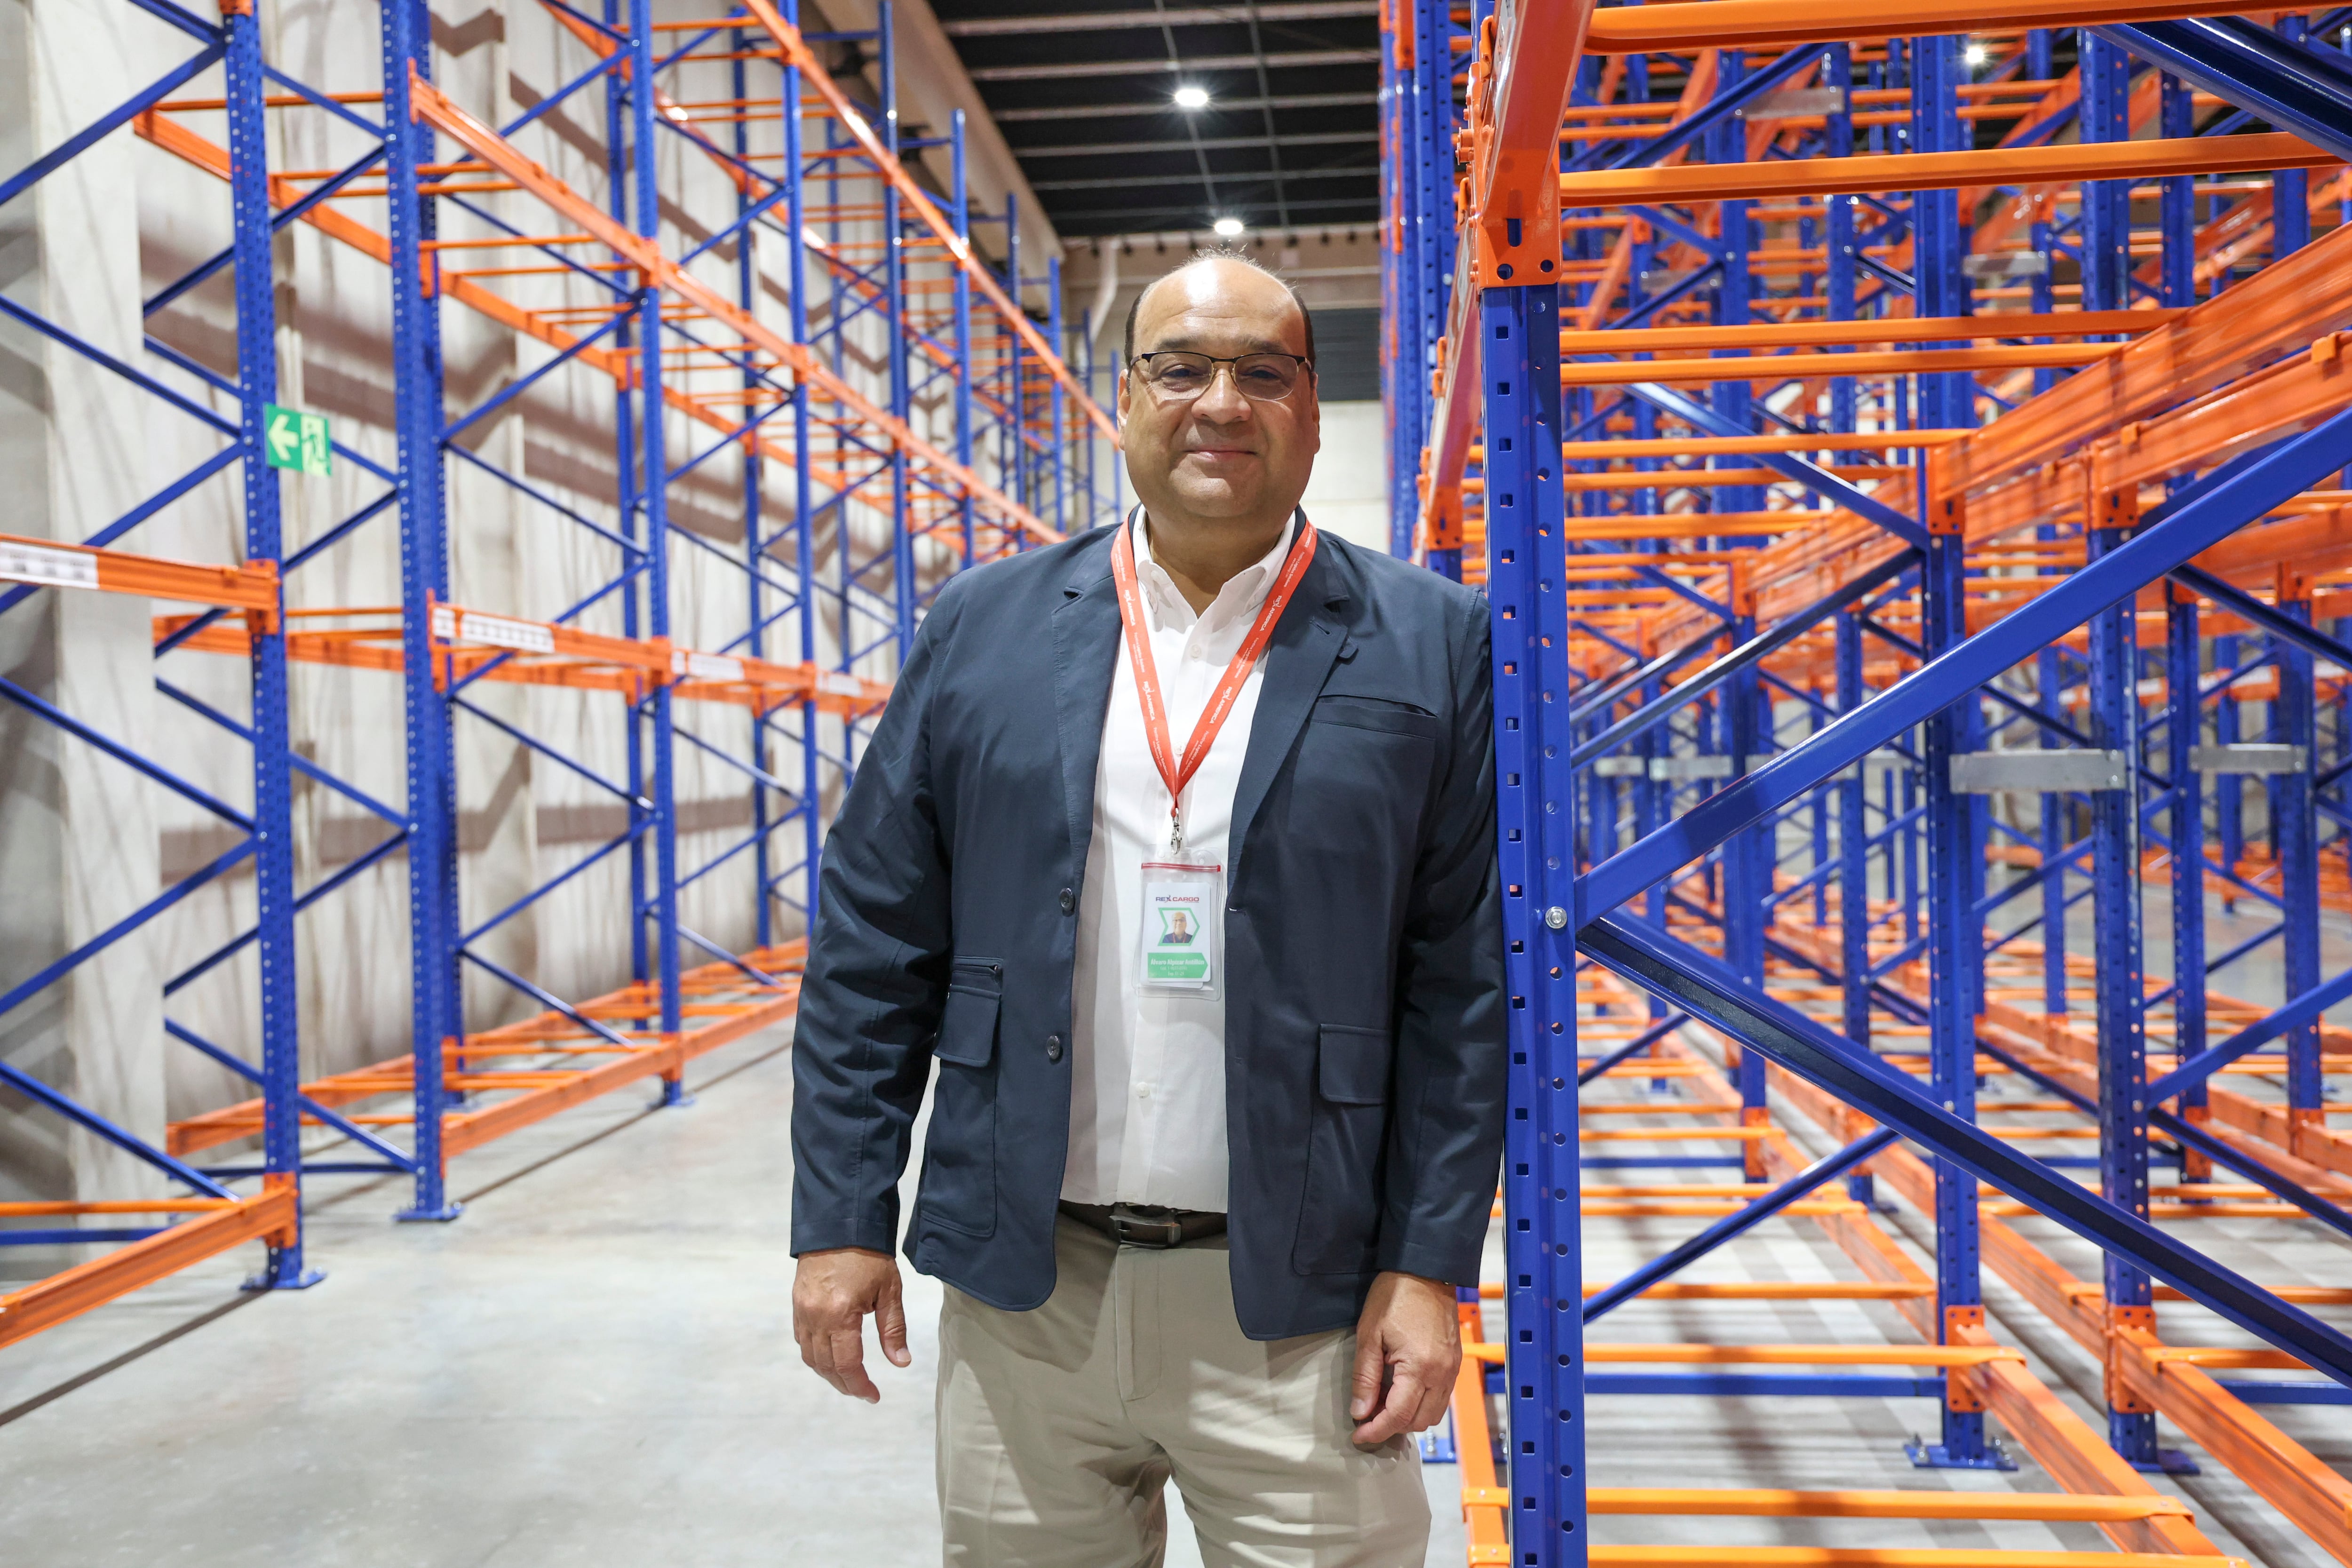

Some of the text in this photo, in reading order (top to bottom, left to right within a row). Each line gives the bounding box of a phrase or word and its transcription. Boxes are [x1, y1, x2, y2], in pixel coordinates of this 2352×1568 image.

[1127, 602, 1136, 626] AMERICA
[1260, 596, 1282, 631] REX AMERICA
[1145, 693, 1156, 721] AMERICA
[1209, 686, 1232, 724] REX AMERICA
[1190, 744, 1202, 761] Logistics
